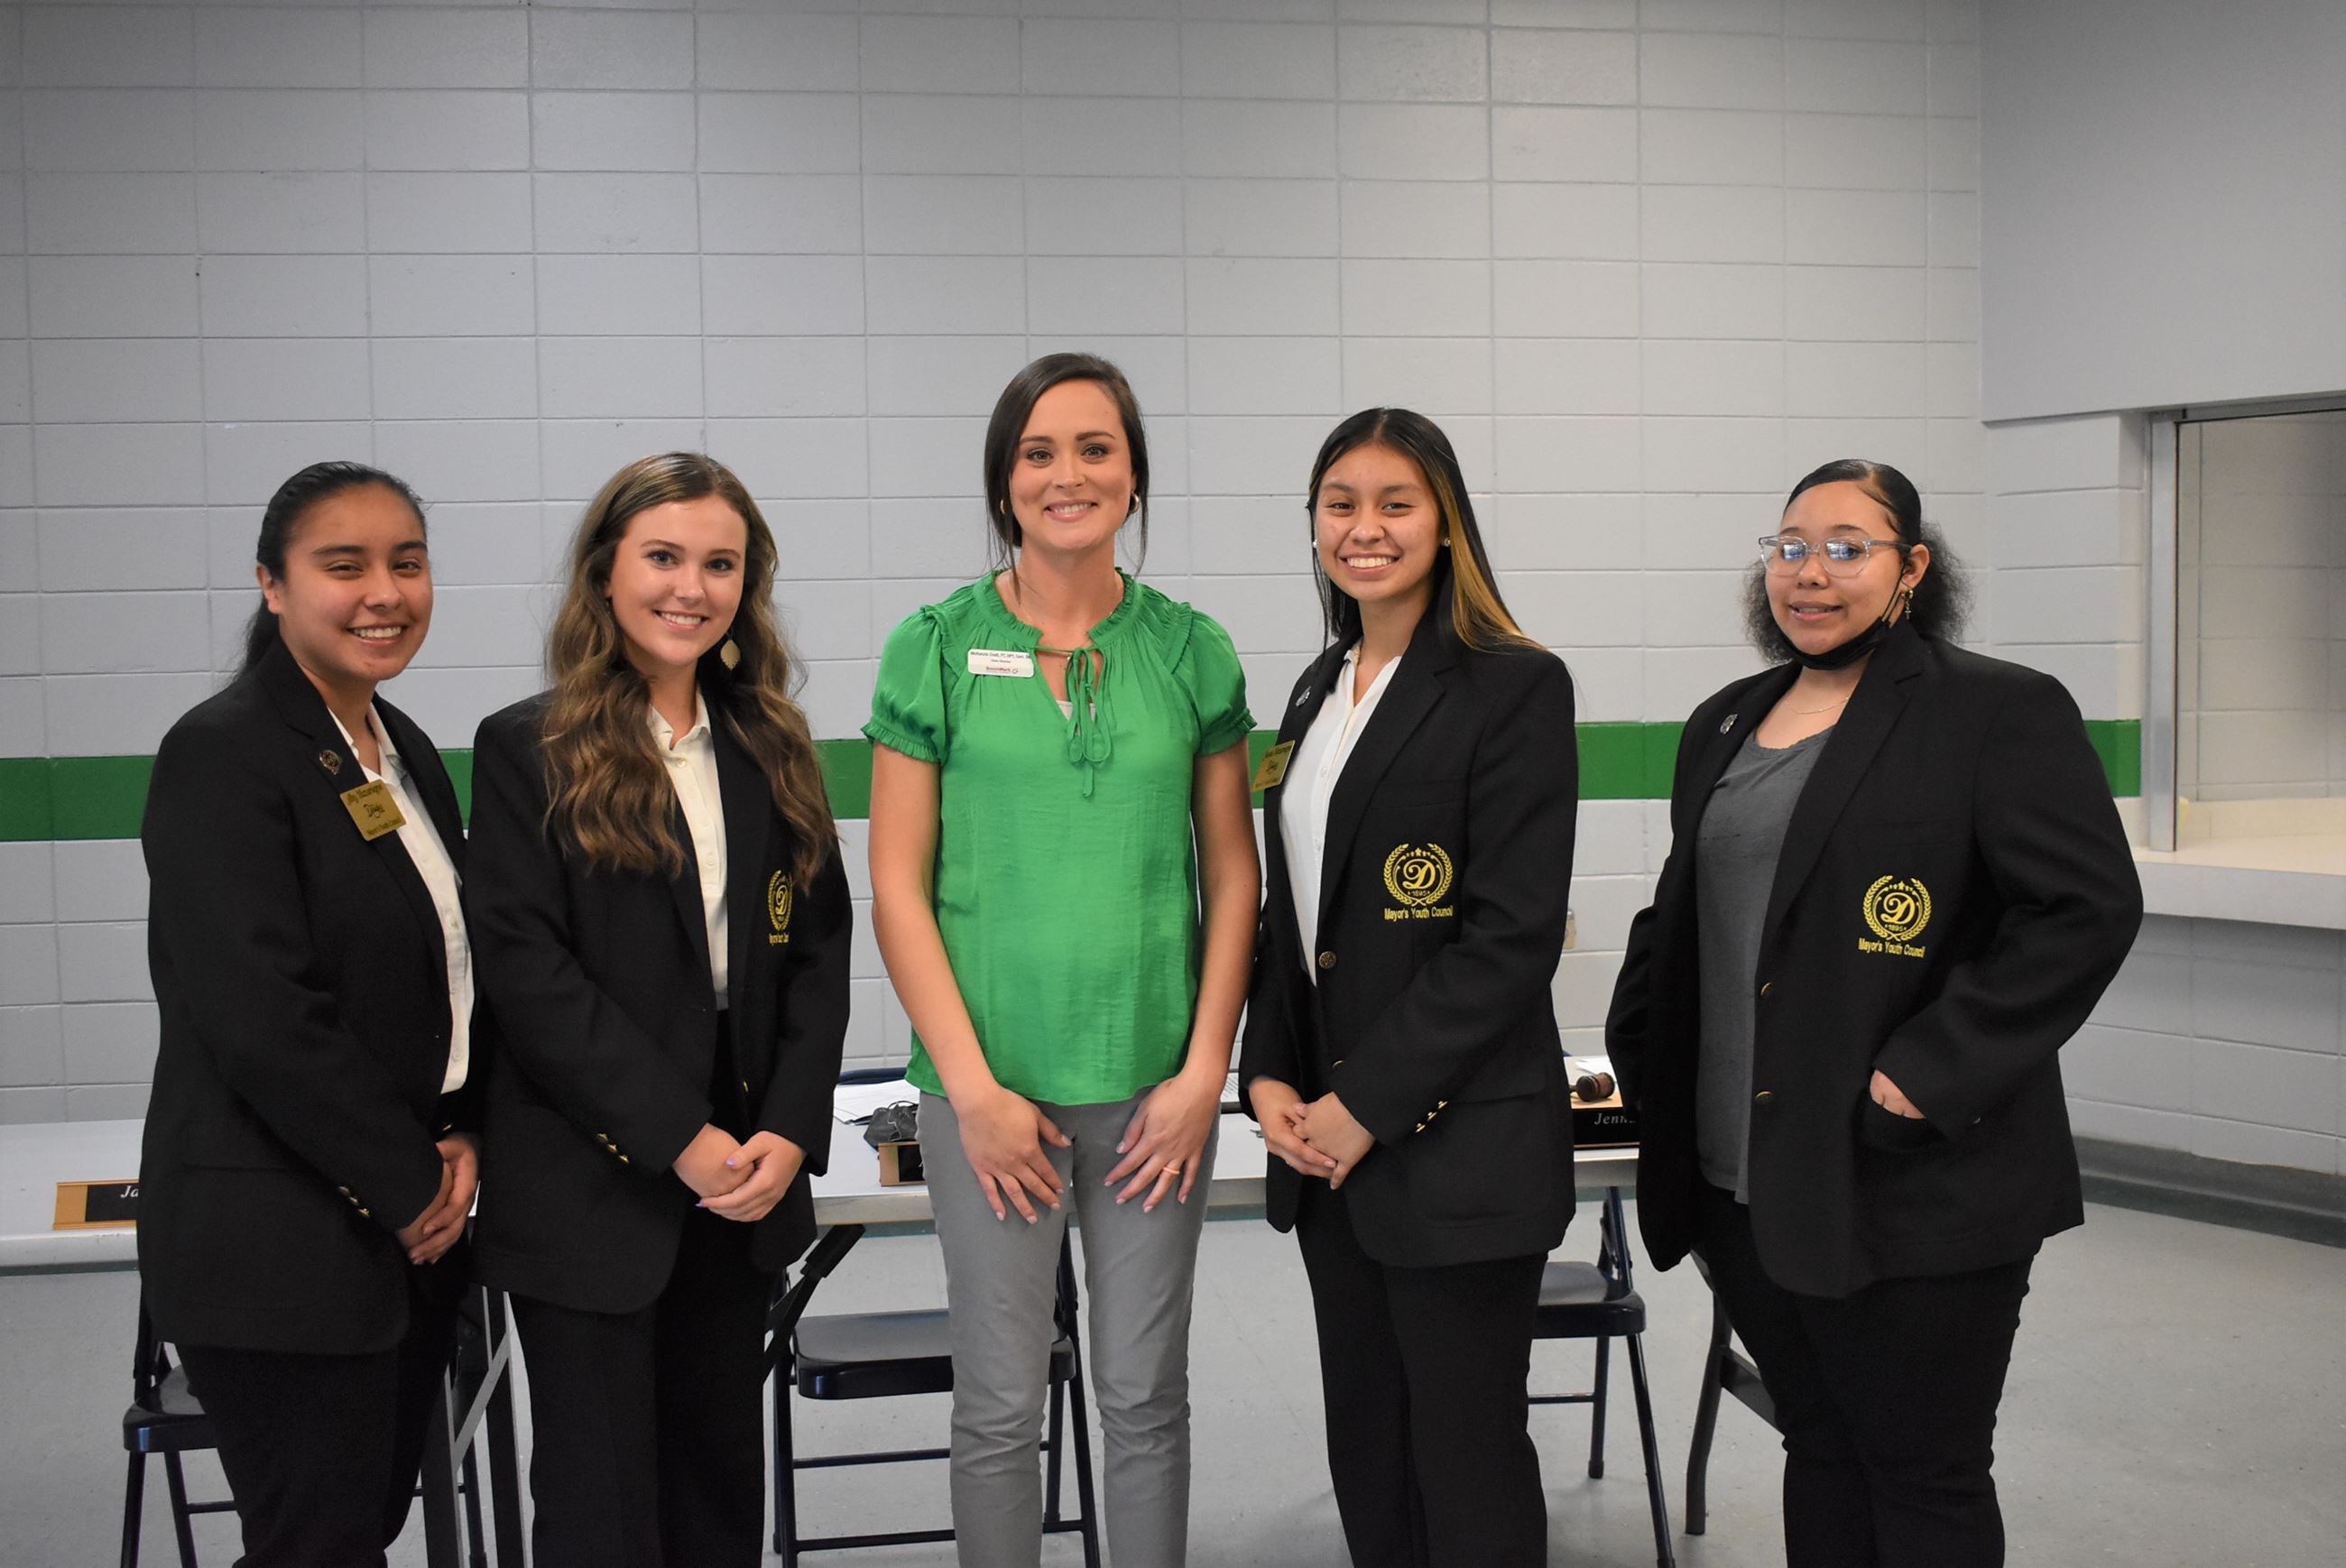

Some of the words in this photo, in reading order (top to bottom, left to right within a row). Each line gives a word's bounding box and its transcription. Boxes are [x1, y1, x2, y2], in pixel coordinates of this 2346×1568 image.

[1402, 858, 1436, 890] D
[1384, 908, 1409, 922] Mayor's
[1410, 907, 1430, 919] Youth
[1431, 905, 1454, 918] Council
[1880, 891, 1915, 925] D
[1858, 937, 1883, 954] Mayor's
[1885, 941, 1903, 955] Youth
[1904, 944, 1926, 958] Council
[1593, 1112, 1636, 1125] Jenn
